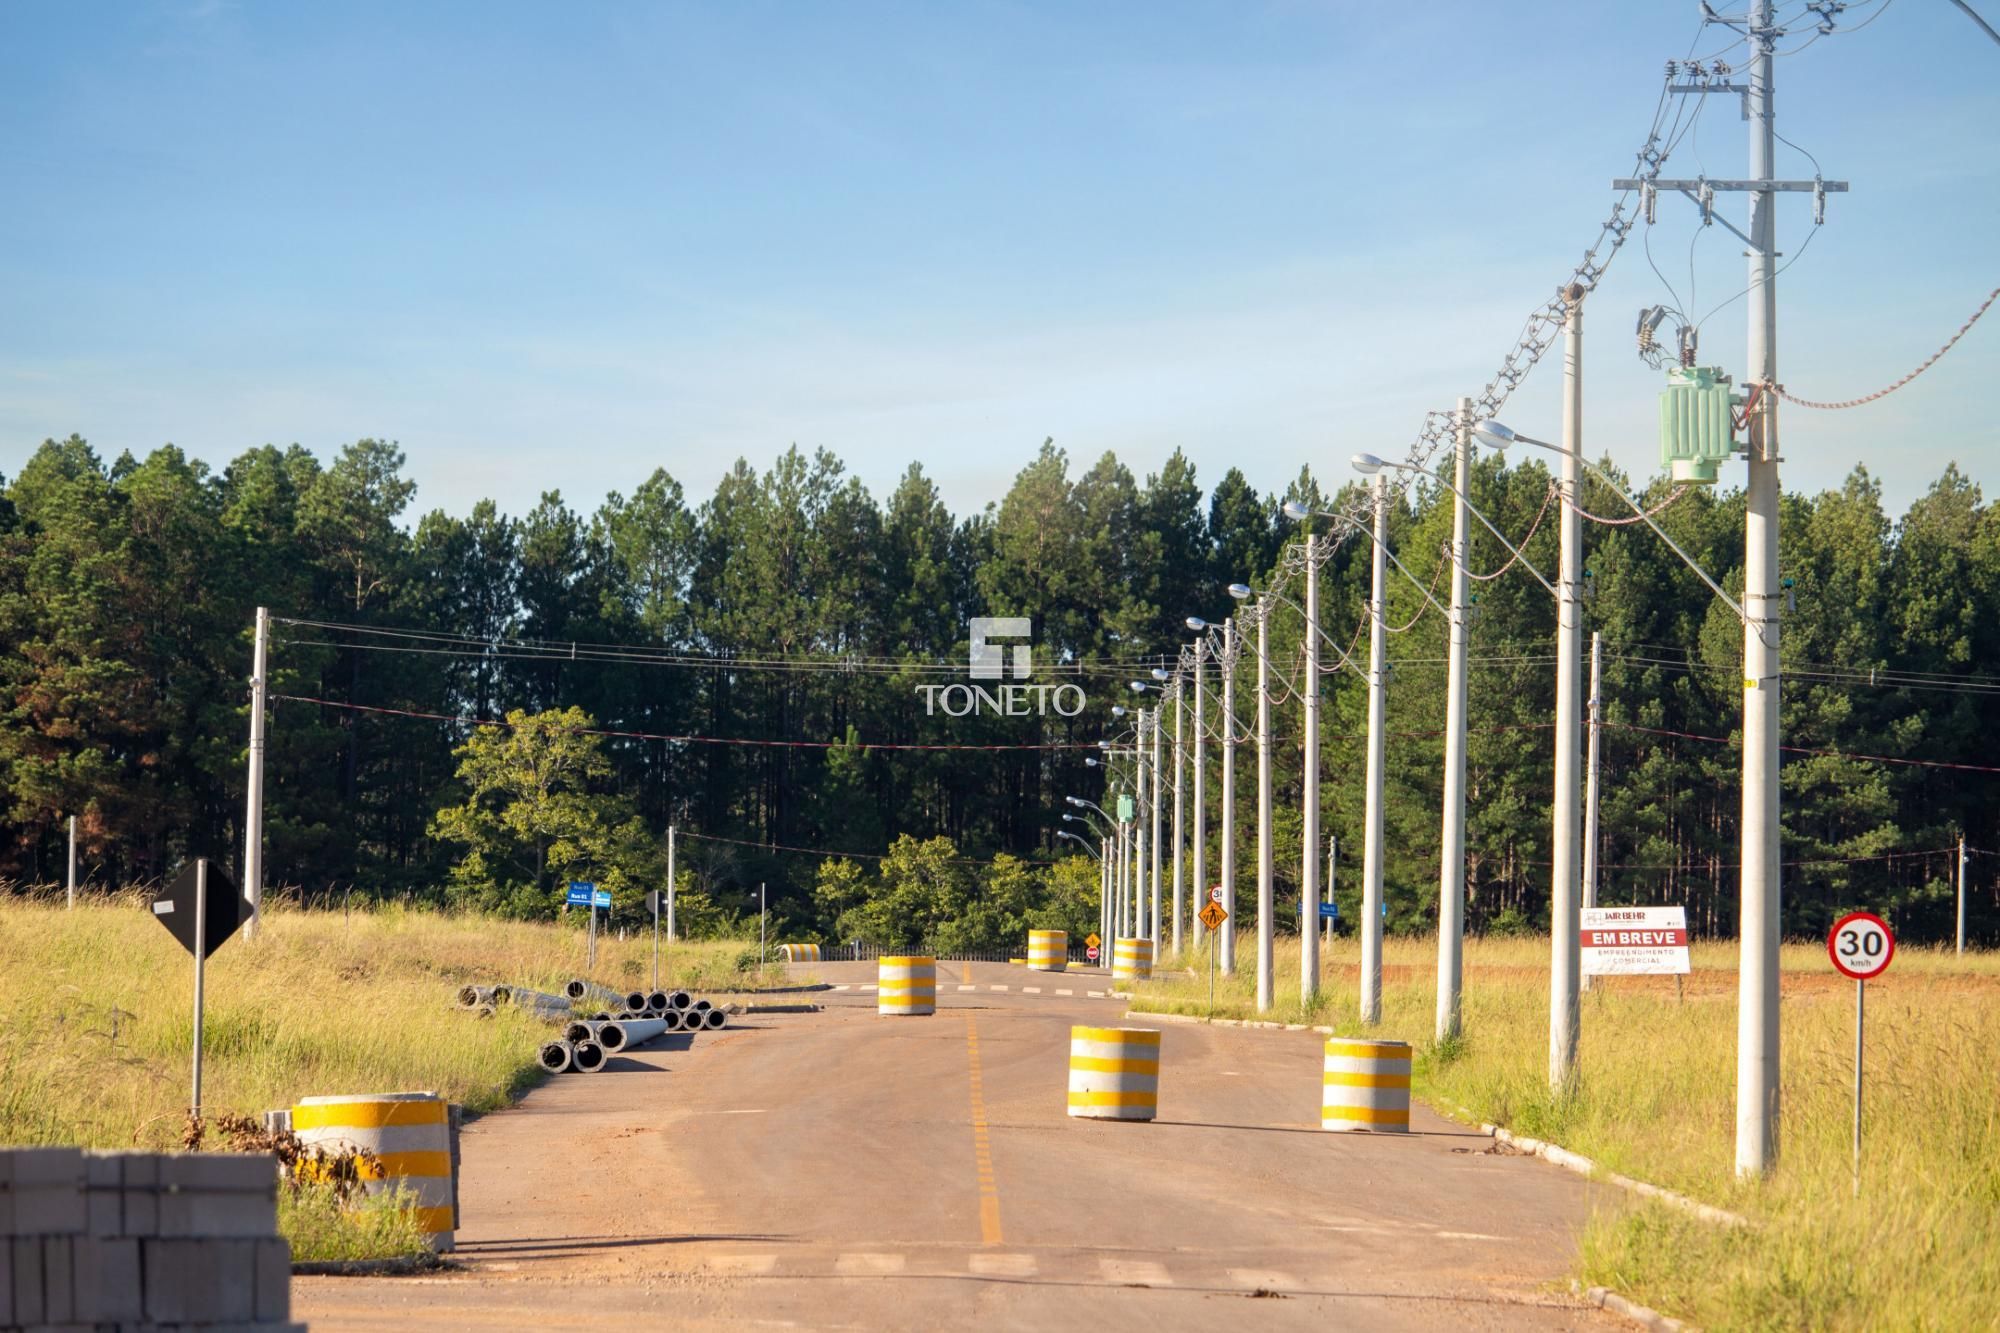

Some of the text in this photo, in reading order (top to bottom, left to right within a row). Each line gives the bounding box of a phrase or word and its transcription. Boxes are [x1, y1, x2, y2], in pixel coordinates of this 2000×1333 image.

[1604, 911, 1646, 920] JAIR BEHR
[1592, 931, 1676, 945] EM BREVE
[1839, 930, 1883, 957] 30
[1850, 959, 1872, 967] km/h
